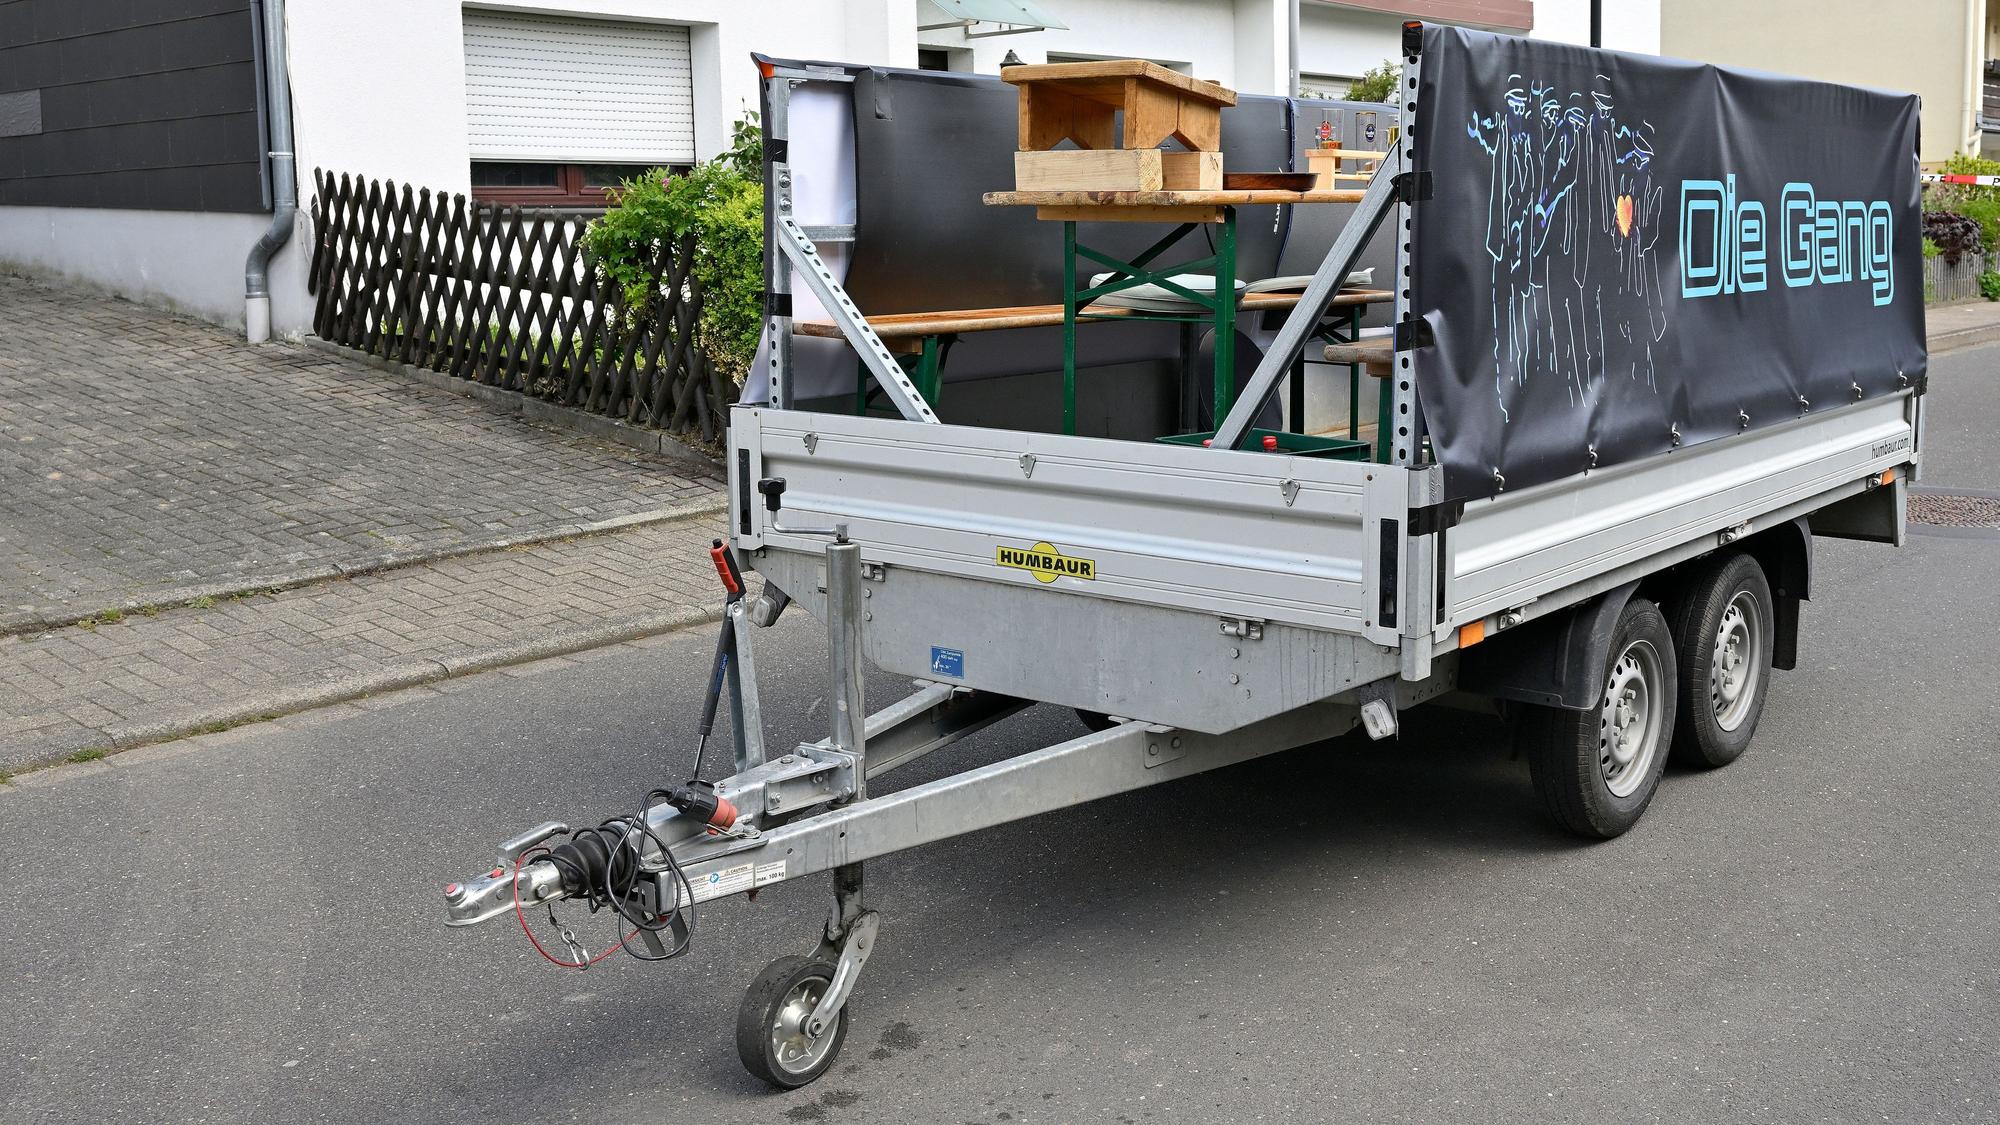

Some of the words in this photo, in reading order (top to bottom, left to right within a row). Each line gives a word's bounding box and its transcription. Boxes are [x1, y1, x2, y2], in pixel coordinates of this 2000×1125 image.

[1679, 173, 1767, 299] Die
[1780, 182, 1895, 307] Gang
[1871, 437, 1909, 459] humbaur.com
[1000, 549, 1091, 576] HUMBAUR
